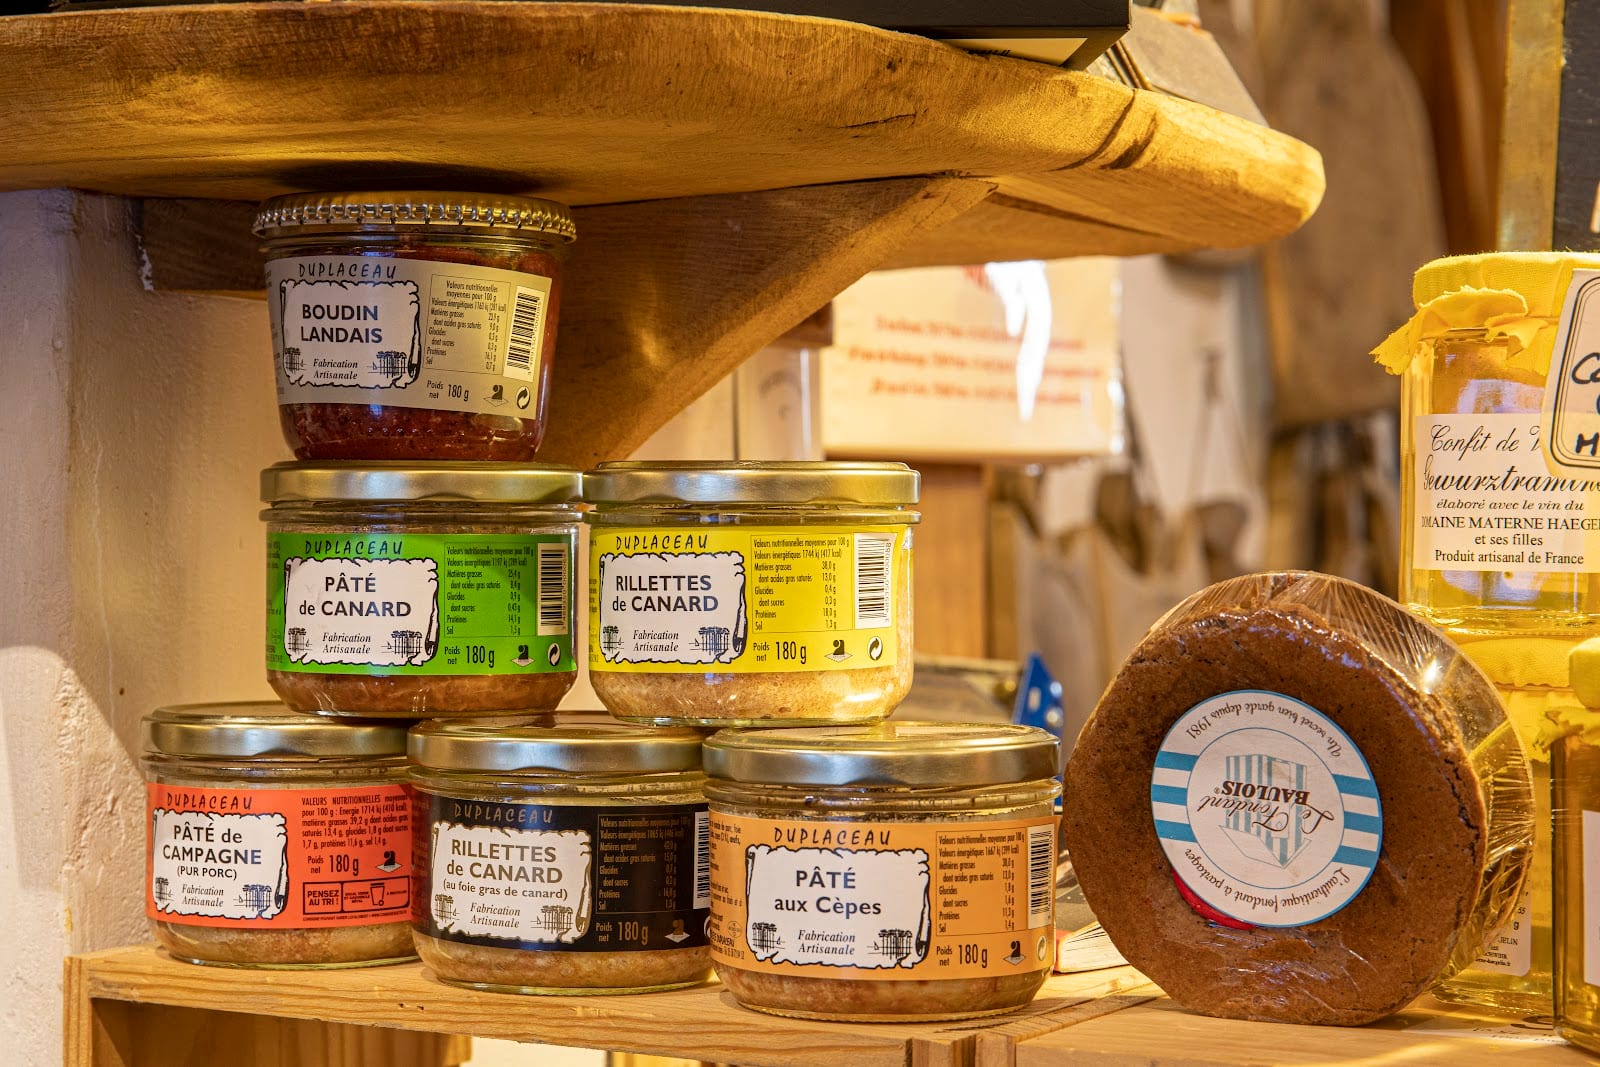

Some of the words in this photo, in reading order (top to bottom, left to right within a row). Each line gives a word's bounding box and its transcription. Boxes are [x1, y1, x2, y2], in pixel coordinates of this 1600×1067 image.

[299, 263, 396, 279] DUPLACEAU
[302, 304, 378, 321] BOUDIN
[300, 326, 382, 343] LANDAIS
[313, 358, 358, 369] Fabrication
[314, 370, 358, 379] Artisanale
[427, 380, 443, 390] Poids
[448, 384, 462, 399] 180
[464, 390, 469, 401] g
[1431, 425, 1491, 461] Confit
[1496, 427, 1519, 451] de
[1436, 499, 1486, 510] élaboré
[1489, 502, 1518, 510] avec
[1523, 500, 1534, 510] le
[1539, 502, 1560, 510] vin
[1565, 500, 1584, 510] du
[1470, 517, 1543, 529] MATERNE
[305, 540, 403, 555] DUPLACEAU
[616, 534, 708, 550] DUPLACEAU
[1475, 535, 1485, 544] et
[1490, 536, 1508, 545] ses
[1513, 535, 1543, 545] filles
[1435, 550, 1475, 562] Produit
[1478, 552, 1524, 563] artisanal
[1528, 553, 1540, 563] de
[1546, 552, 1584, 564] France
[325, 572, 376, 592] PÂTÉ
[616, 575, 712, 591] RILLETTES
[299, 602, 316, 615] de
[322, 601, 411, 617] CANARD
[613, 596, 627, 611] de
[632, 596, 719, 612] CANARD
[322, 632, 371, 643] Fabrication
[633, 630, 679, 641] Fabrication
[323, 644, 371, 654] Artisanale
[444, 647, 460, 656] Poids
[634, 641, 678, 652] Artisanale
[753, 642, 769, 651] Poids
[776, 641, 797, 660] 180
[800, 646, 806, 664] g
[447, 657, 457, 665] net
[466, 646, 485, 663] 180
[488, 649, 494, 668] g
[756, 653, 767, 662] net
[1211, 703, 1242, 718] depuis
[1245, 703, 1275, 717] gardé
[1277, 705, 1299, 722] bien
[1185, 715, 1213, 739] 1981
[1300, 716, 1326, 736] secret
[1325, 736, 1342, 758] Un
[168, 793, 252, 809] DUPLACEAU
[302, 797, 327, 805] VALEURS
[333, 795, 380, 804] NUTRITIONNELLES
[454, 803, 553, 824] DUPLACEAU
[1197, 795, 1290, 832] Fondant
[1291, 803, 1334, 834] Le
[302, 819, 326, 827] matières
[328, 818, 347, 827] grasses
[350, 817, 362, 825] 39,2
[174, 822, 214, 842] PÂTÉ
[222, 829, 242, 843] de
[774, 827, 890, 845] DUPLACEAU
[163, 845, 262, 865] CAMPAGNE
[451, 839, 556, 862] RILLETTES
[307, 856, 324, 864] Poids
[329, 854, 350, 872] 180
[352, 859, 359, 876] g
[1185, 848, 1225, 887] partager
[177, 867, 199, 877] (PUR
[202, 868, 237, 880] PORC)
[311, 866, 320, 874] net
[447, 861, 464, 876] de
[470, 863, 562, 883] CANARD
[796, 866, 856, 889] PÂTÉ
[182, 884, 224, 896] Fabrication
[307, 890, 339, 898] PENSEZ
[443, 878, 456, 891] (au
[458, 880, 476, 893] foie
[479, 885, 500, 897] gras
[503, 887, 518, 896] de
[521, 887, 567, 901] canard)
[1225, 885, 1234, 895] à
[1280, 868, 1351, 907] L'authentique
[182, 896, 223, 907] Artisanale
[309, 898, 323, 906] AU
[324, 897, 334, 905] TRI
[1234, 887, 1278, 912] fondant
[470, 902, 520, 917] Fabrication
[774, 898, 807, 912] aux
[816, 896, 881, 919] Cèpes
[470, 915, 520, 928] Artisanale
[596, 922, 612, 932] Poids
[599, 933, 609, 942] net
[618, 921, 638, 941] 180
[641, 926, 648, 945] g
[798, 929, 855, 943] Fabrication
[798, 943, 855, 955] Artisanale
[936, 945, 952, 955] Poids
[959, 944, 978, 963] 180
[981, 949, 987, 968] g
[939, 956, 949, 966] net
